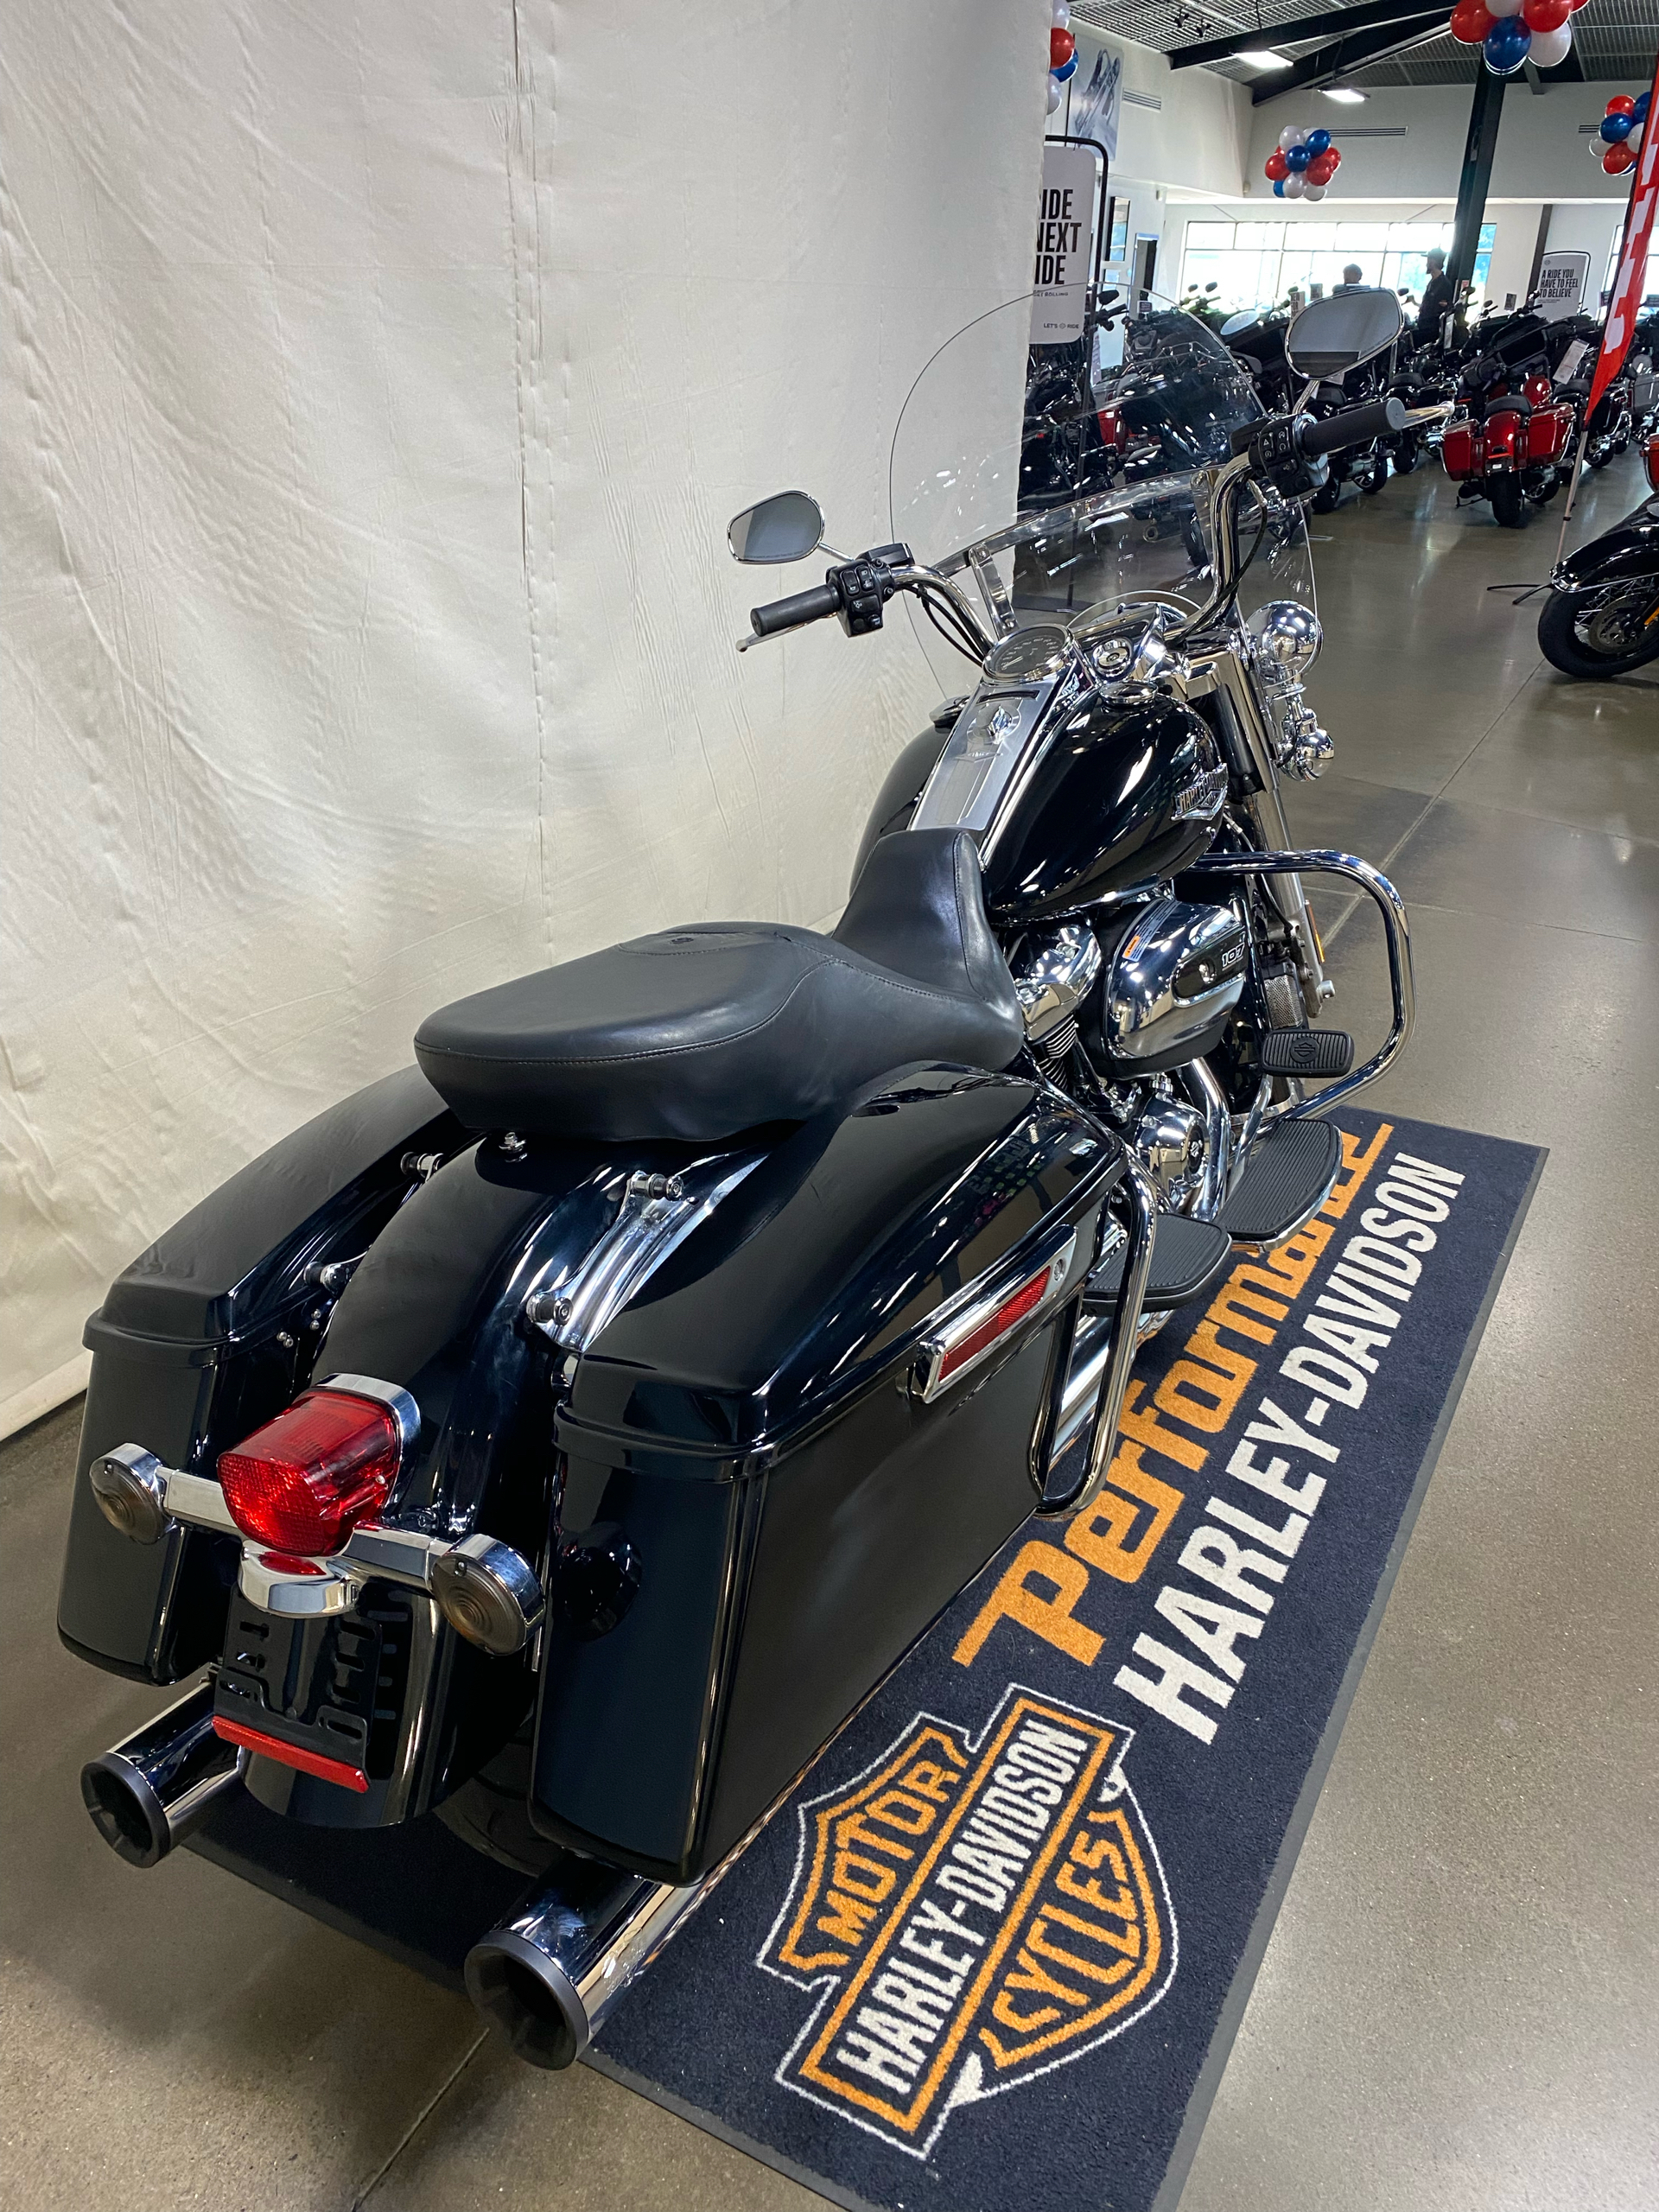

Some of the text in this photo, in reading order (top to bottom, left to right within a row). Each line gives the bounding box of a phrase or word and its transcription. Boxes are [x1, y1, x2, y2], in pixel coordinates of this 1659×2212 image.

[1039, 188, 1073, 219] IDE
[1034, 255, 1066, 284] IDE
[1540, 278, 1579, 289] HAVE TO FEEL
[1541, 268, 1575, 279] A RIDE YOU
[1539, 288, 1573, 298] TO BELIEVE
[1222, 942, 1245, 968] 107
[1113, 1152, 1466, 1745] HARLEY-DAVIDSON
[817, 1760, 957, 1946] MOTOR
[836, 1719, 1088, 2095] HARLEY-DAVIDSON
[992, 1830, 1141, 2033] CYCLES
